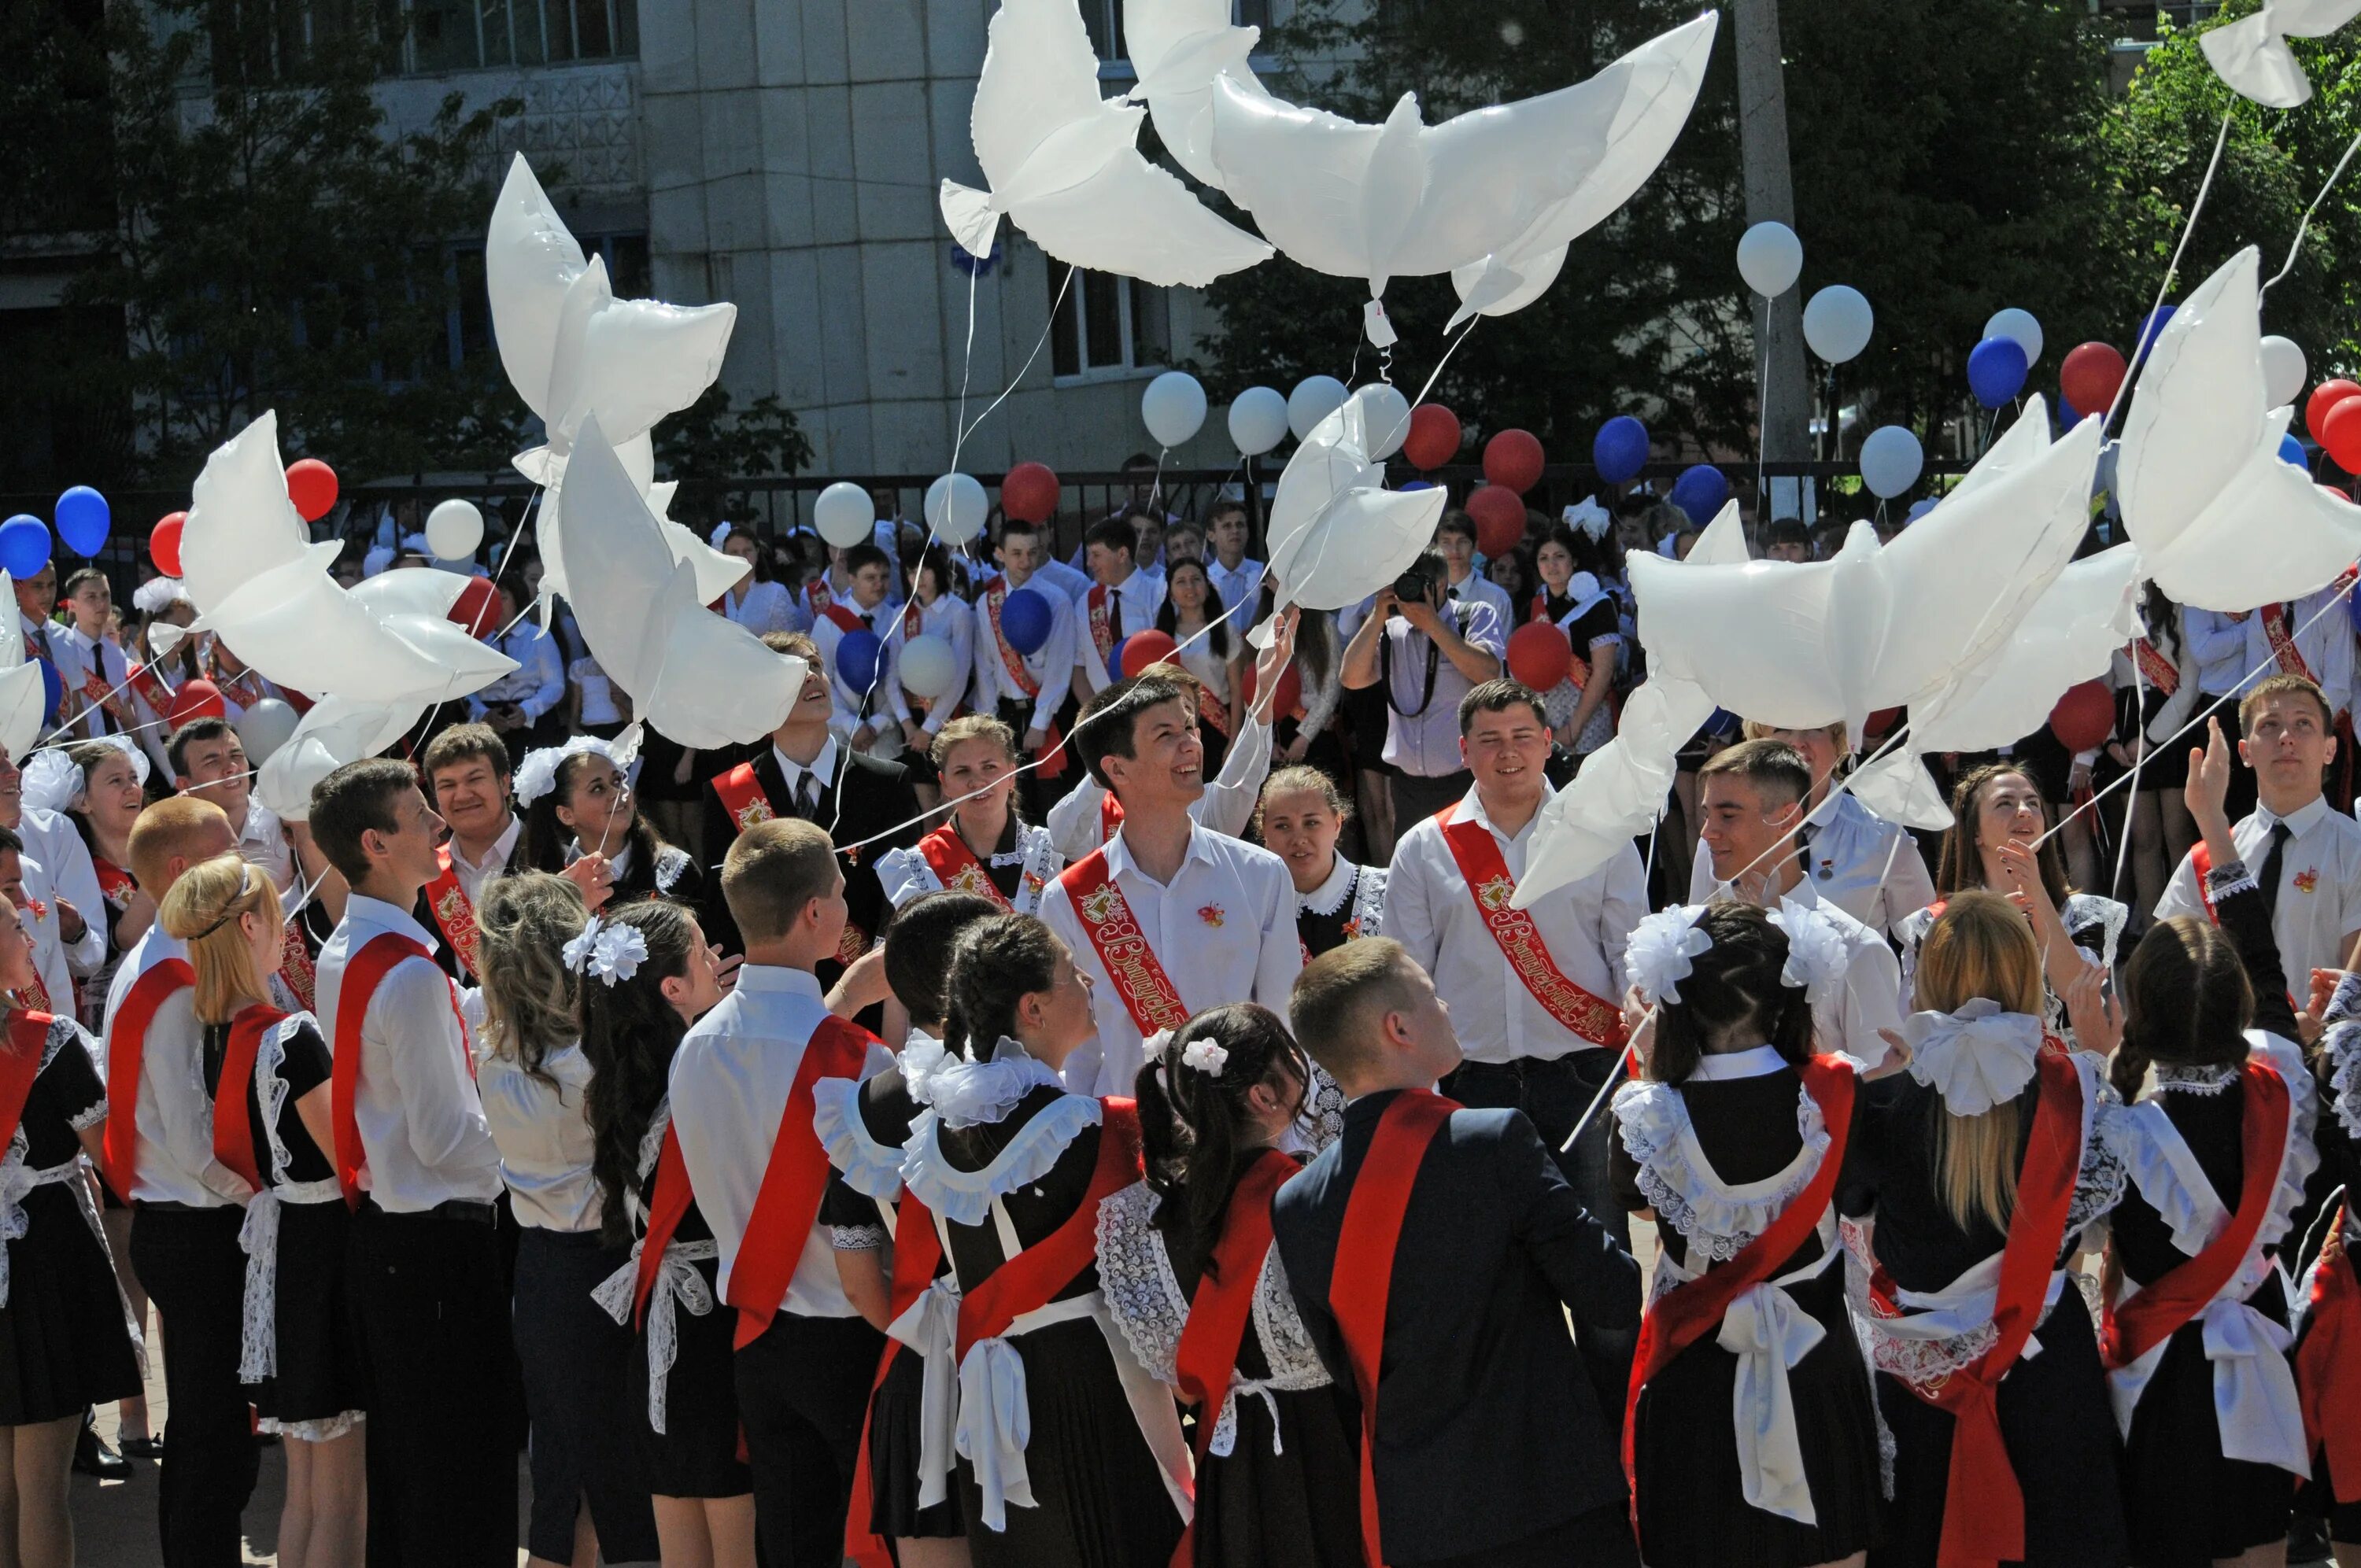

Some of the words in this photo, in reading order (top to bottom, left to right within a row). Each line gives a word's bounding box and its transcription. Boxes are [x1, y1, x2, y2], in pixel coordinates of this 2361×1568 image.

[841, 926, 870, 961] 201
[1096, 922, 1185, 1032] Выпускн
[1490, 911, 1587, 1024] Выпускник
